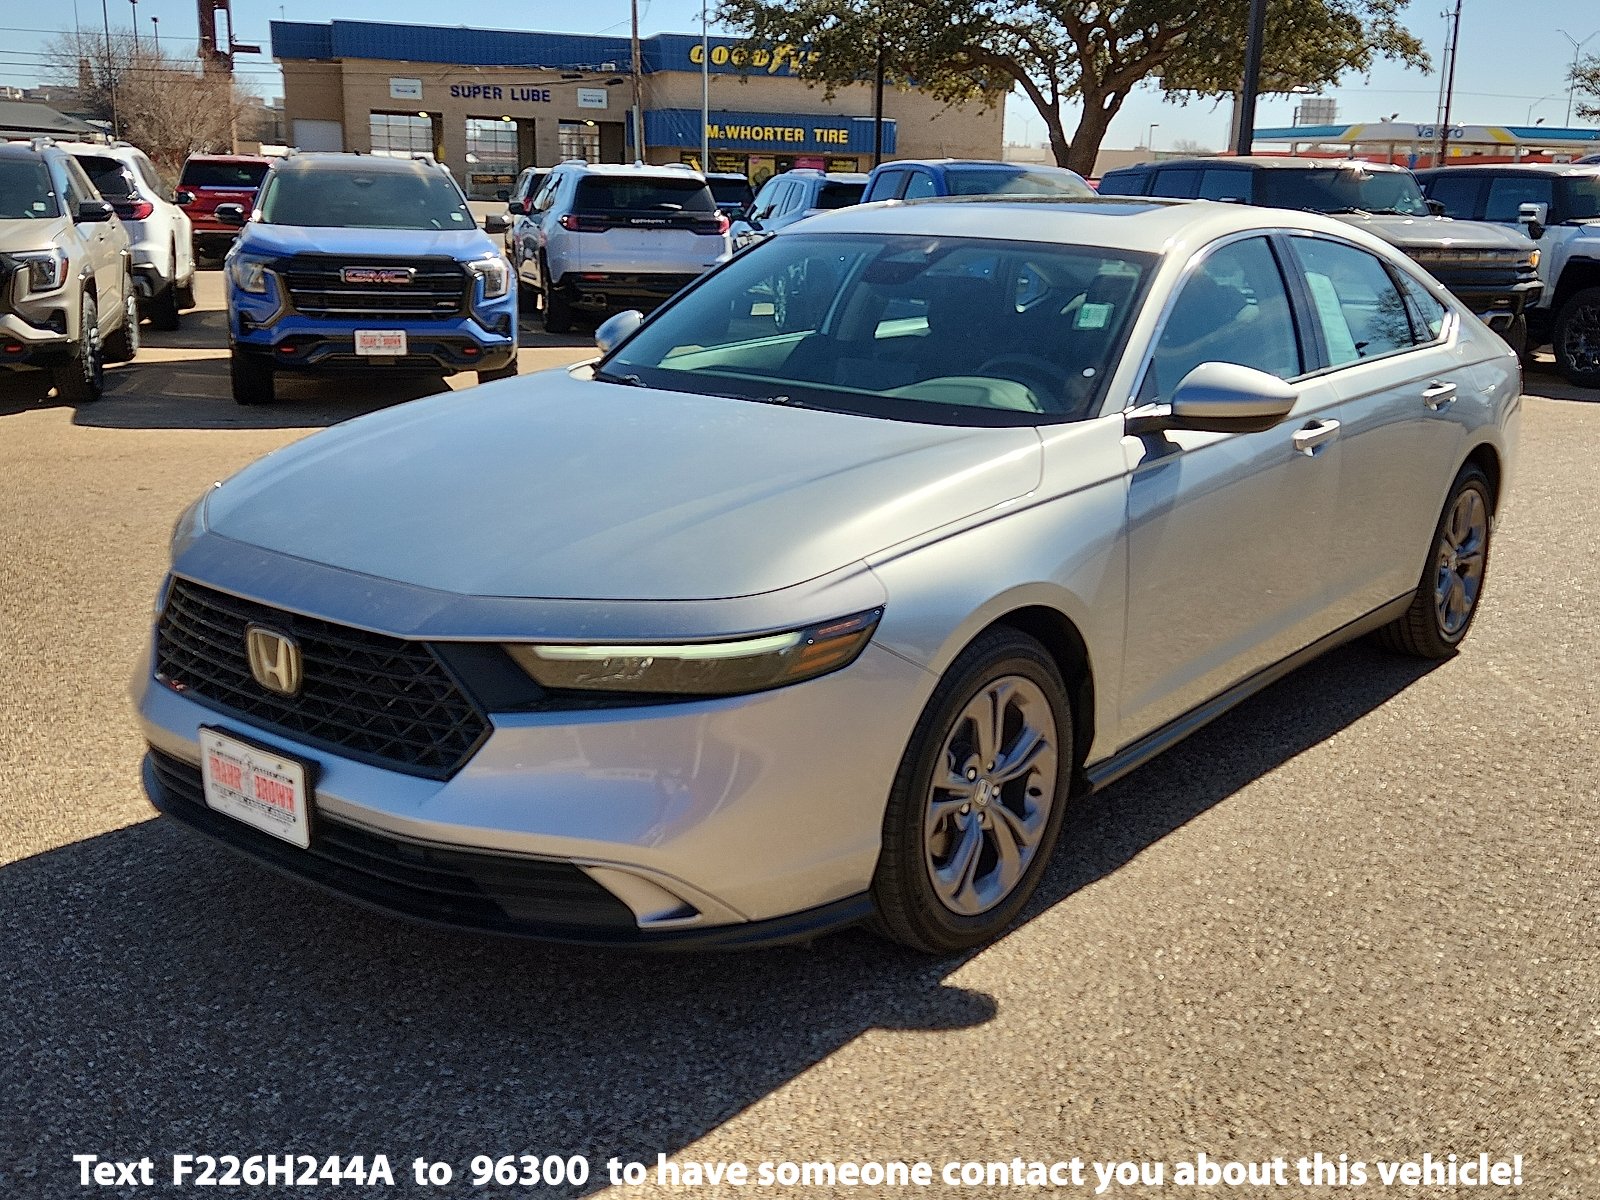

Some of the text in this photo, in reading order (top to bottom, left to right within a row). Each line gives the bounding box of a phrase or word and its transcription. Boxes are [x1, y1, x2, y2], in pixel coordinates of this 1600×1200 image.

[450, 85, 552, 102] SUPER LUBE
[705, 124, 849, 144] McWHORTER TIRE
[1416, 124, 1464, 138] Varo
[345, 269, 410, 284] GMC
